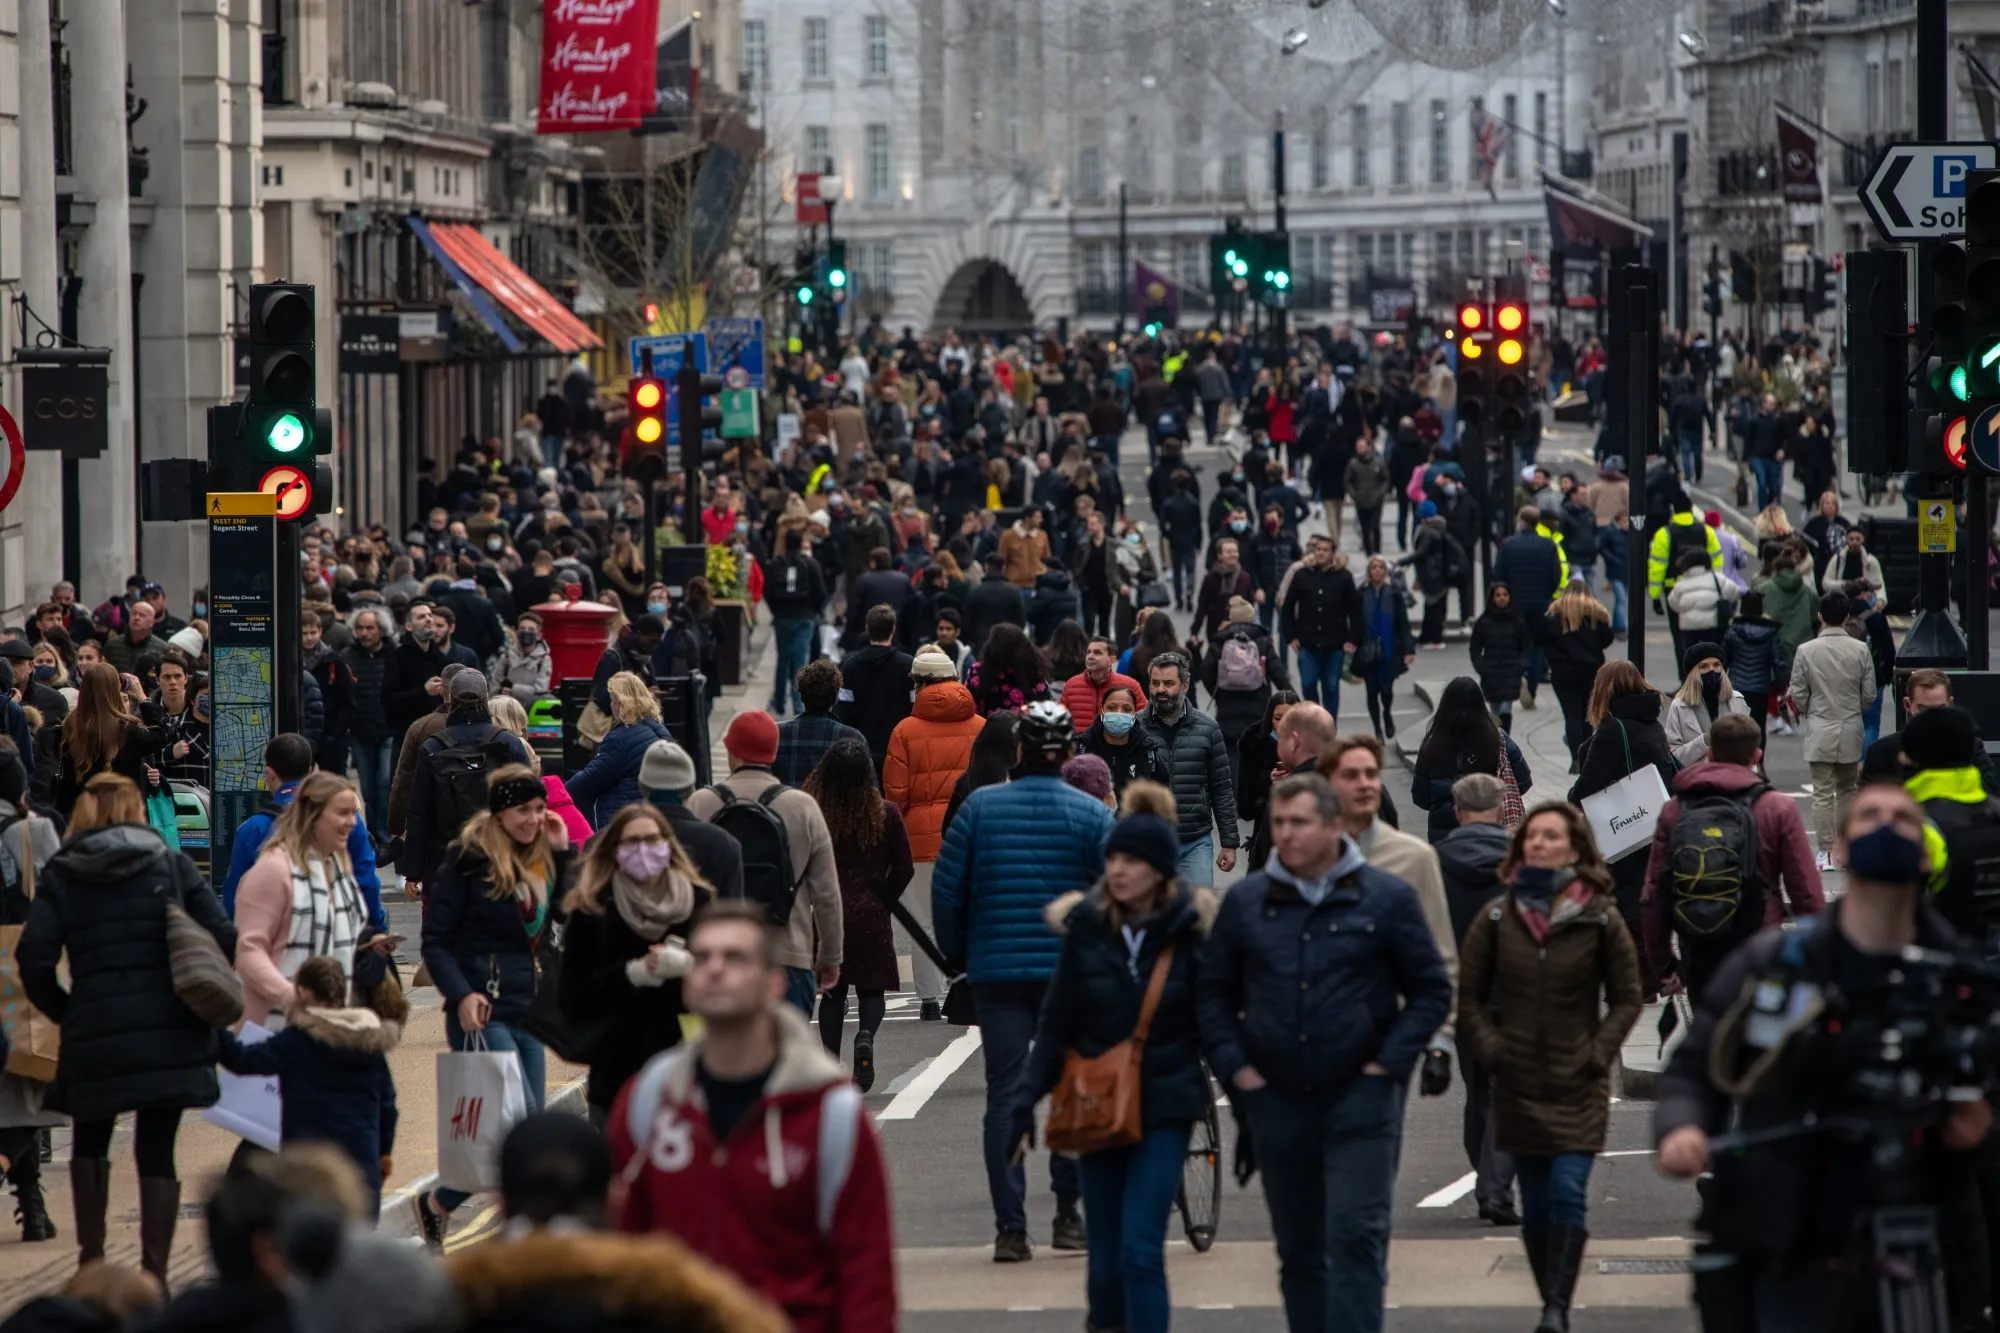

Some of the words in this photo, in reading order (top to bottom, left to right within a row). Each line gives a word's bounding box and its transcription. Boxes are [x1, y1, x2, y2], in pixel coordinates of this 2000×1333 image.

[552, 0, 636, 24] Hamleys
[550, 31, 632, 73] Hamleys
[547, 80, 628, 123] Hamleys
[1943, 160, 1968, 194] P
[34, 398, 97, 419] COS
[1609, 806, 1649, 835] Fenwick
